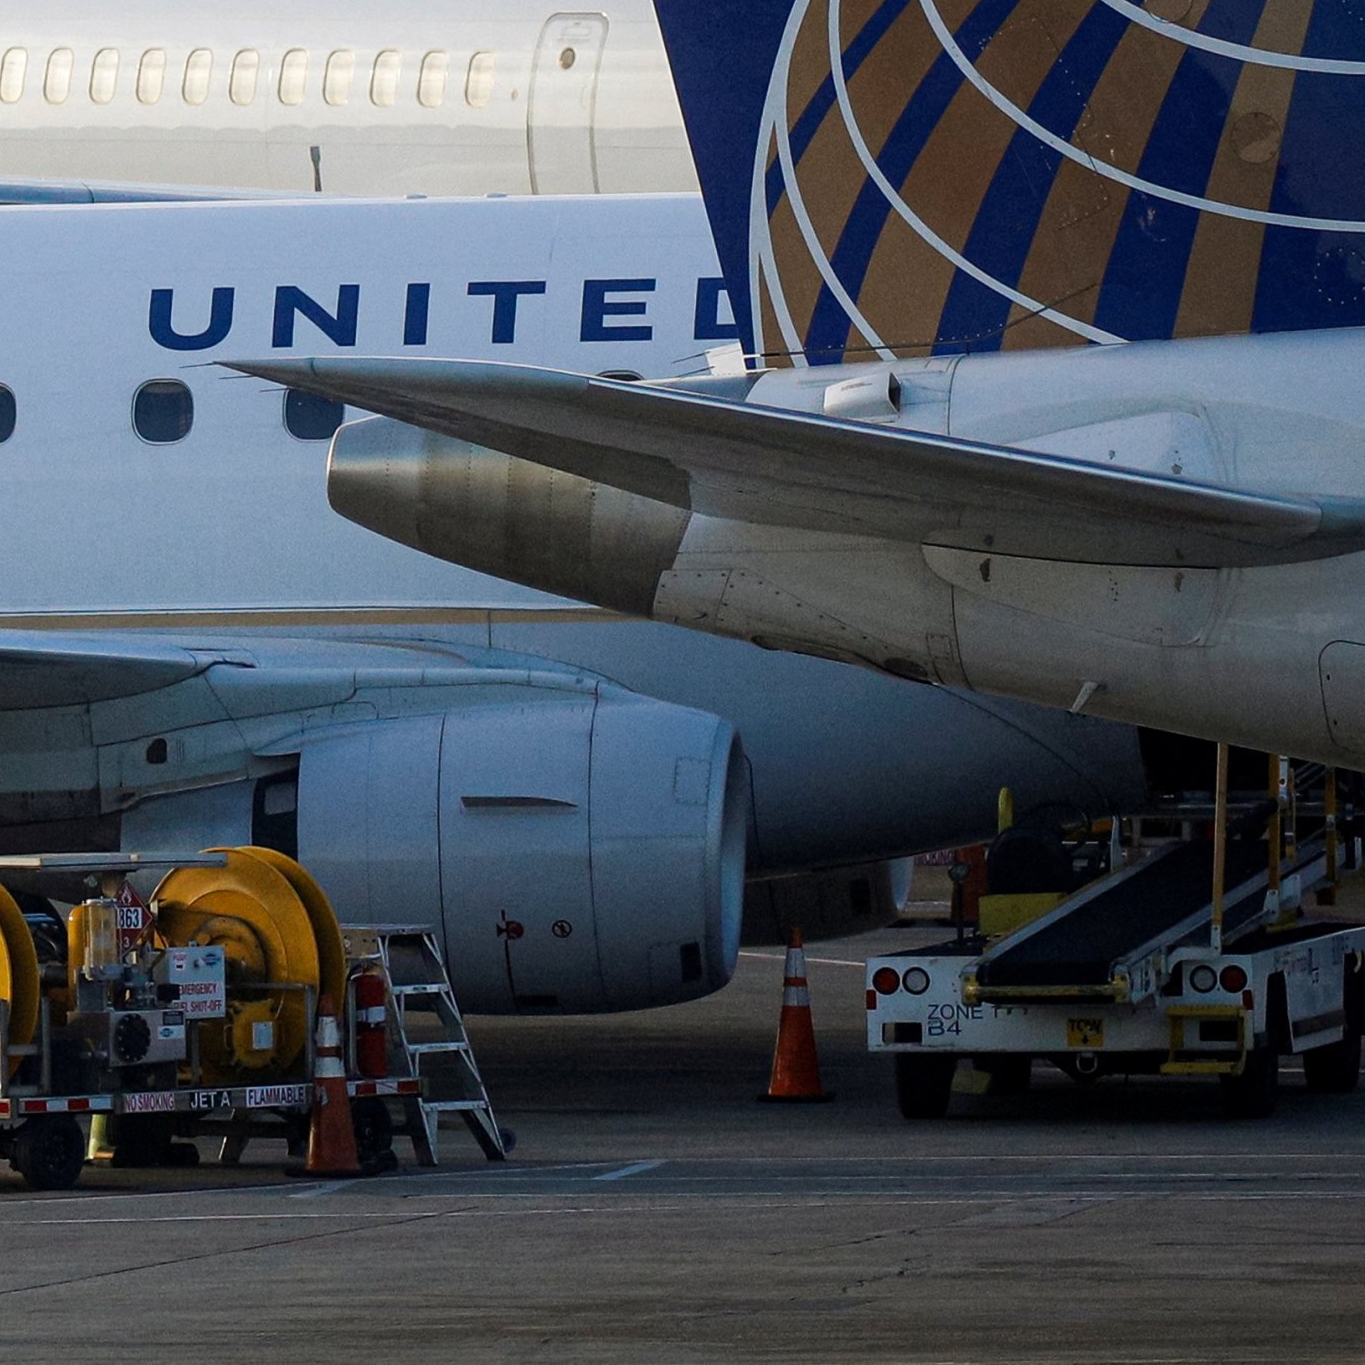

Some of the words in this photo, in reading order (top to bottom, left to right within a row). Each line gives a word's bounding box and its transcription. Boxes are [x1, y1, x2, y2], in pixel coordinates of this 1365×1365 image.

[119, 908, 139, 928] 863
[123, 937, 130, 948] 3
[178, 983, 218, 995] MERGENCY
[191, 1000, 222, 1013] SHUT-OFF
[928, 1004, 983, 1020] ZONE
[137, 1093, 175, 1111] SMOKING
[190, 1092, 217, 1109] JET
[220, 1091, 231, 1107] A
[248, 1086, 305, 1106] FLAMMABLE
